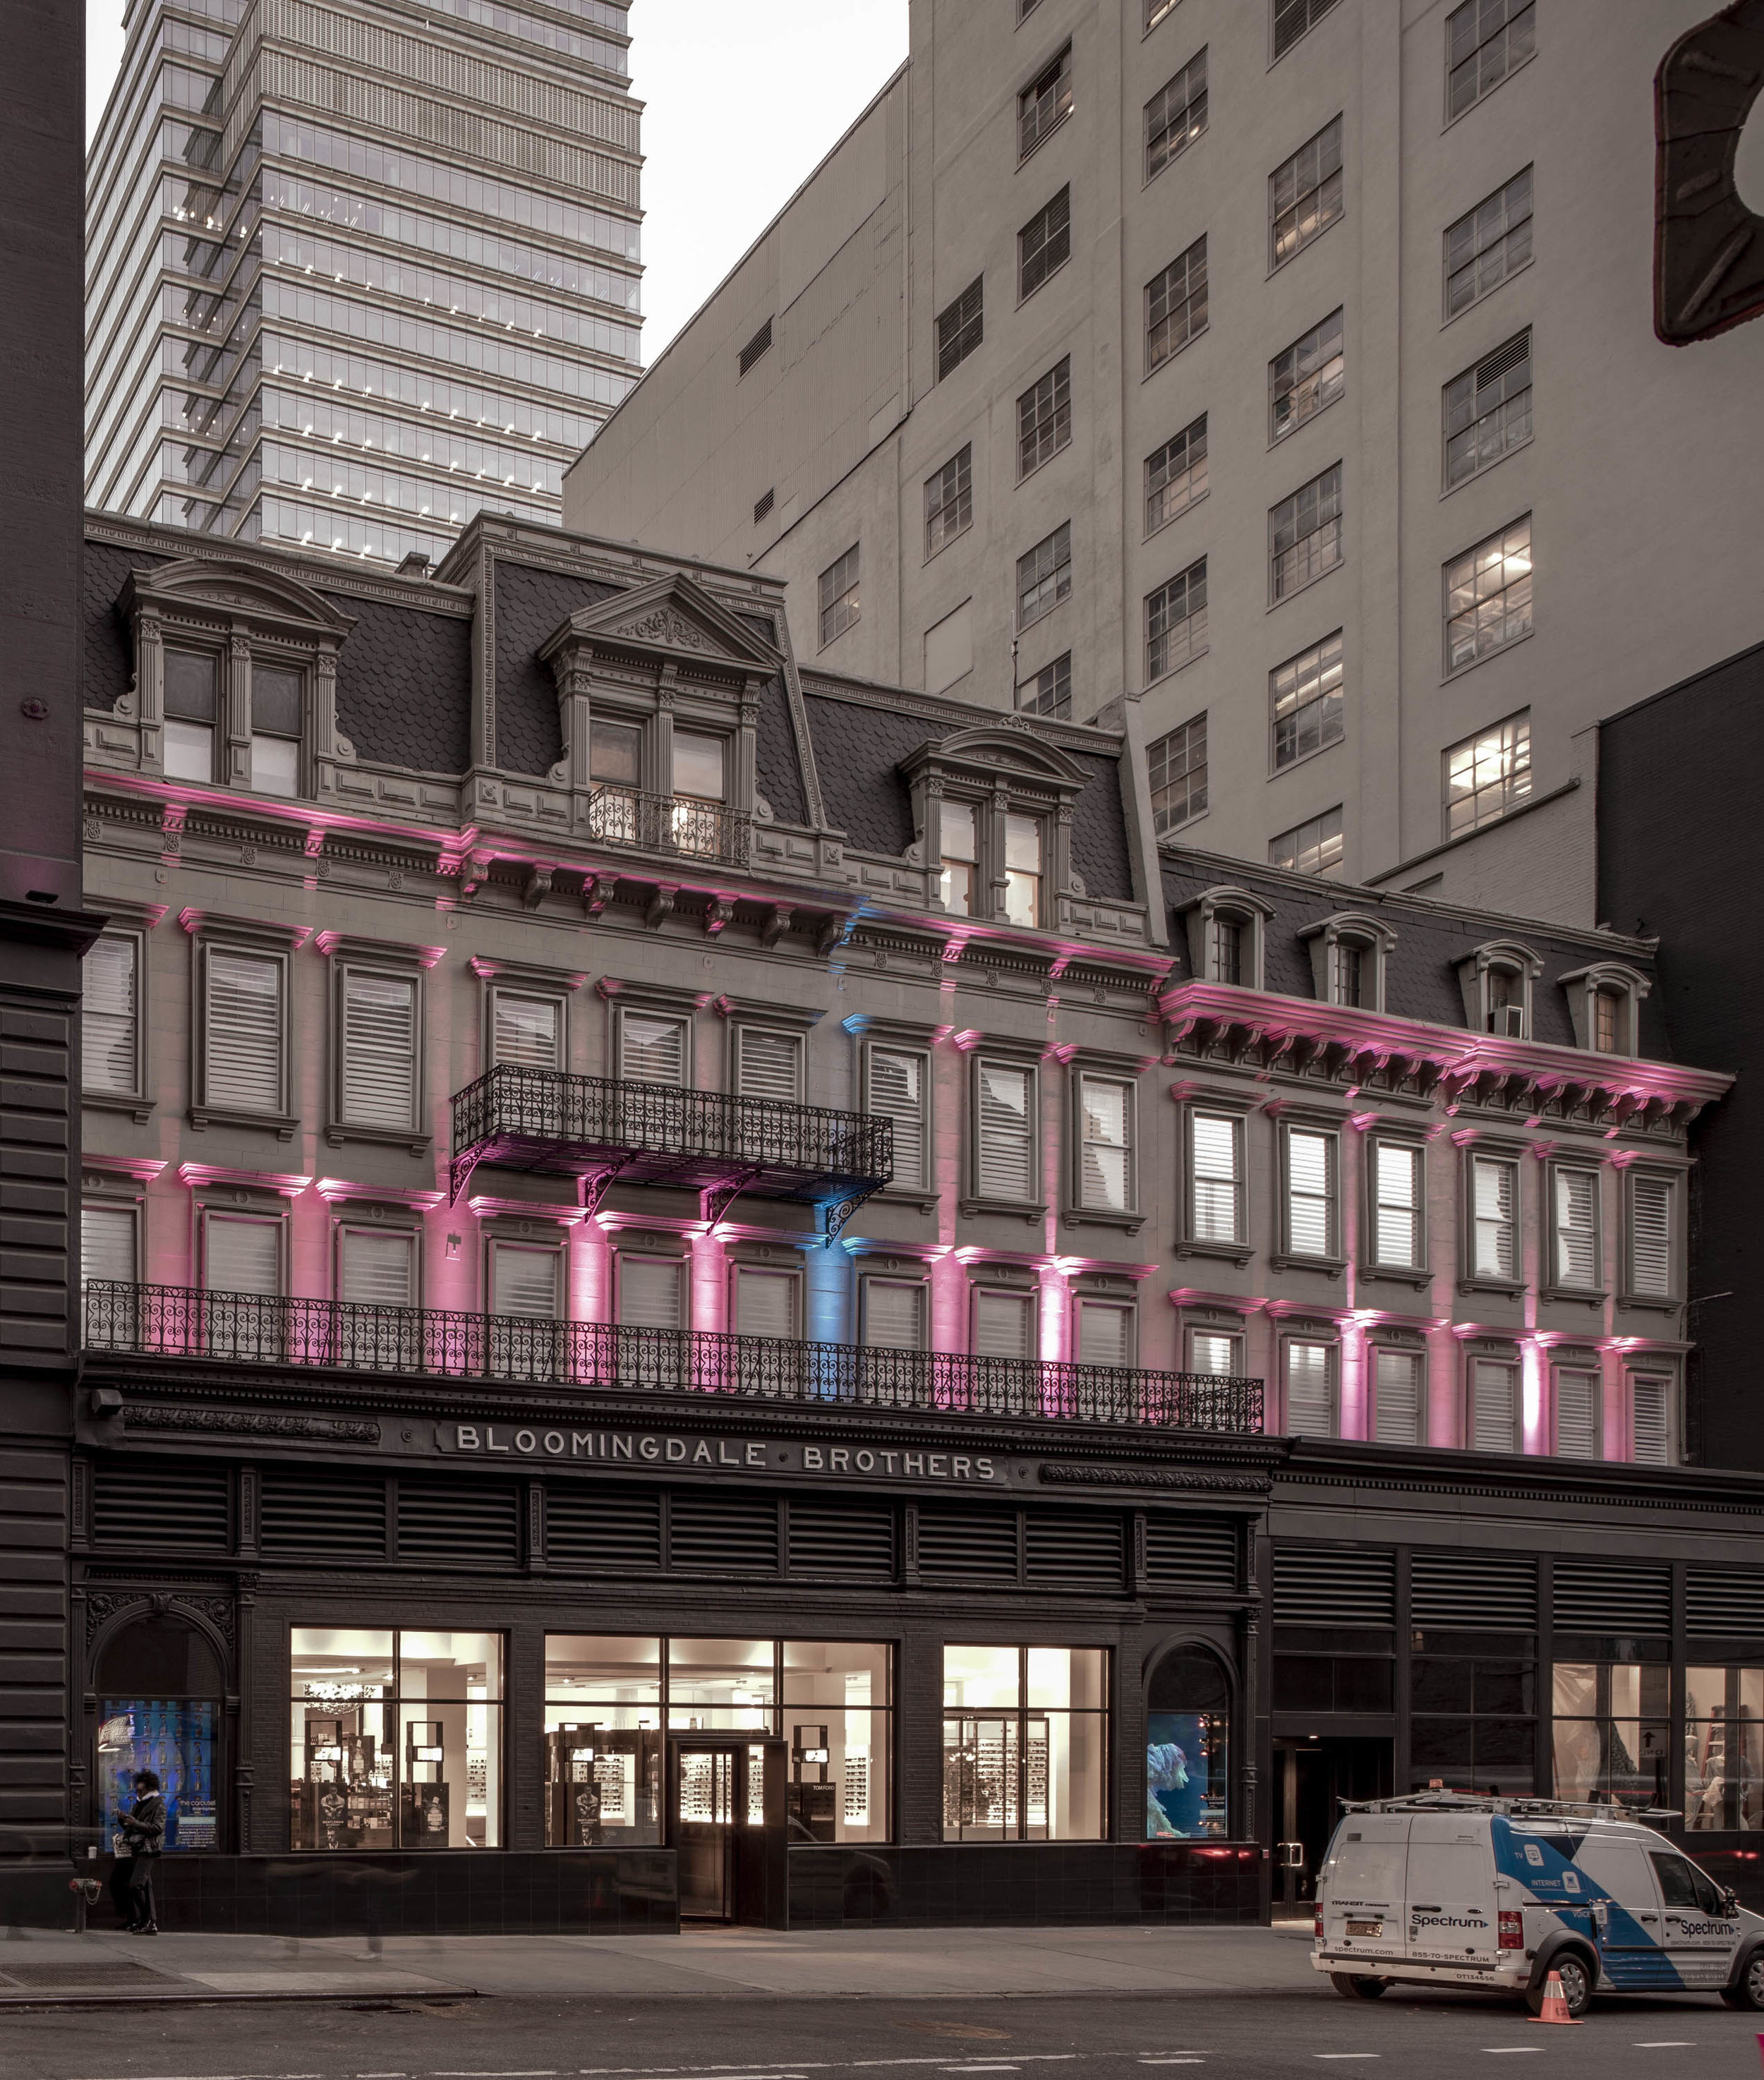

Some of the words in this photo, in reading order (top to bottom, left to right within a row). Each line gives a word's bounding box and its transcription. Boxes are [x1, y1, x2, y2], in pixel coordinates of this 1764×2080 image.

[457, 1425, 767, 1466] BLOOMINGDALE
[803, 1446, 995, 1480] BROTHERS
[1411, 1913, 1483, 1928] Spectrum
[1681, 1920, 1731, 1938] Spectrum
[1334, 1947, 1394, 1956] spectrum.com
[1412, 1952, 1489, 1962] 855-70-SPECTRUM
